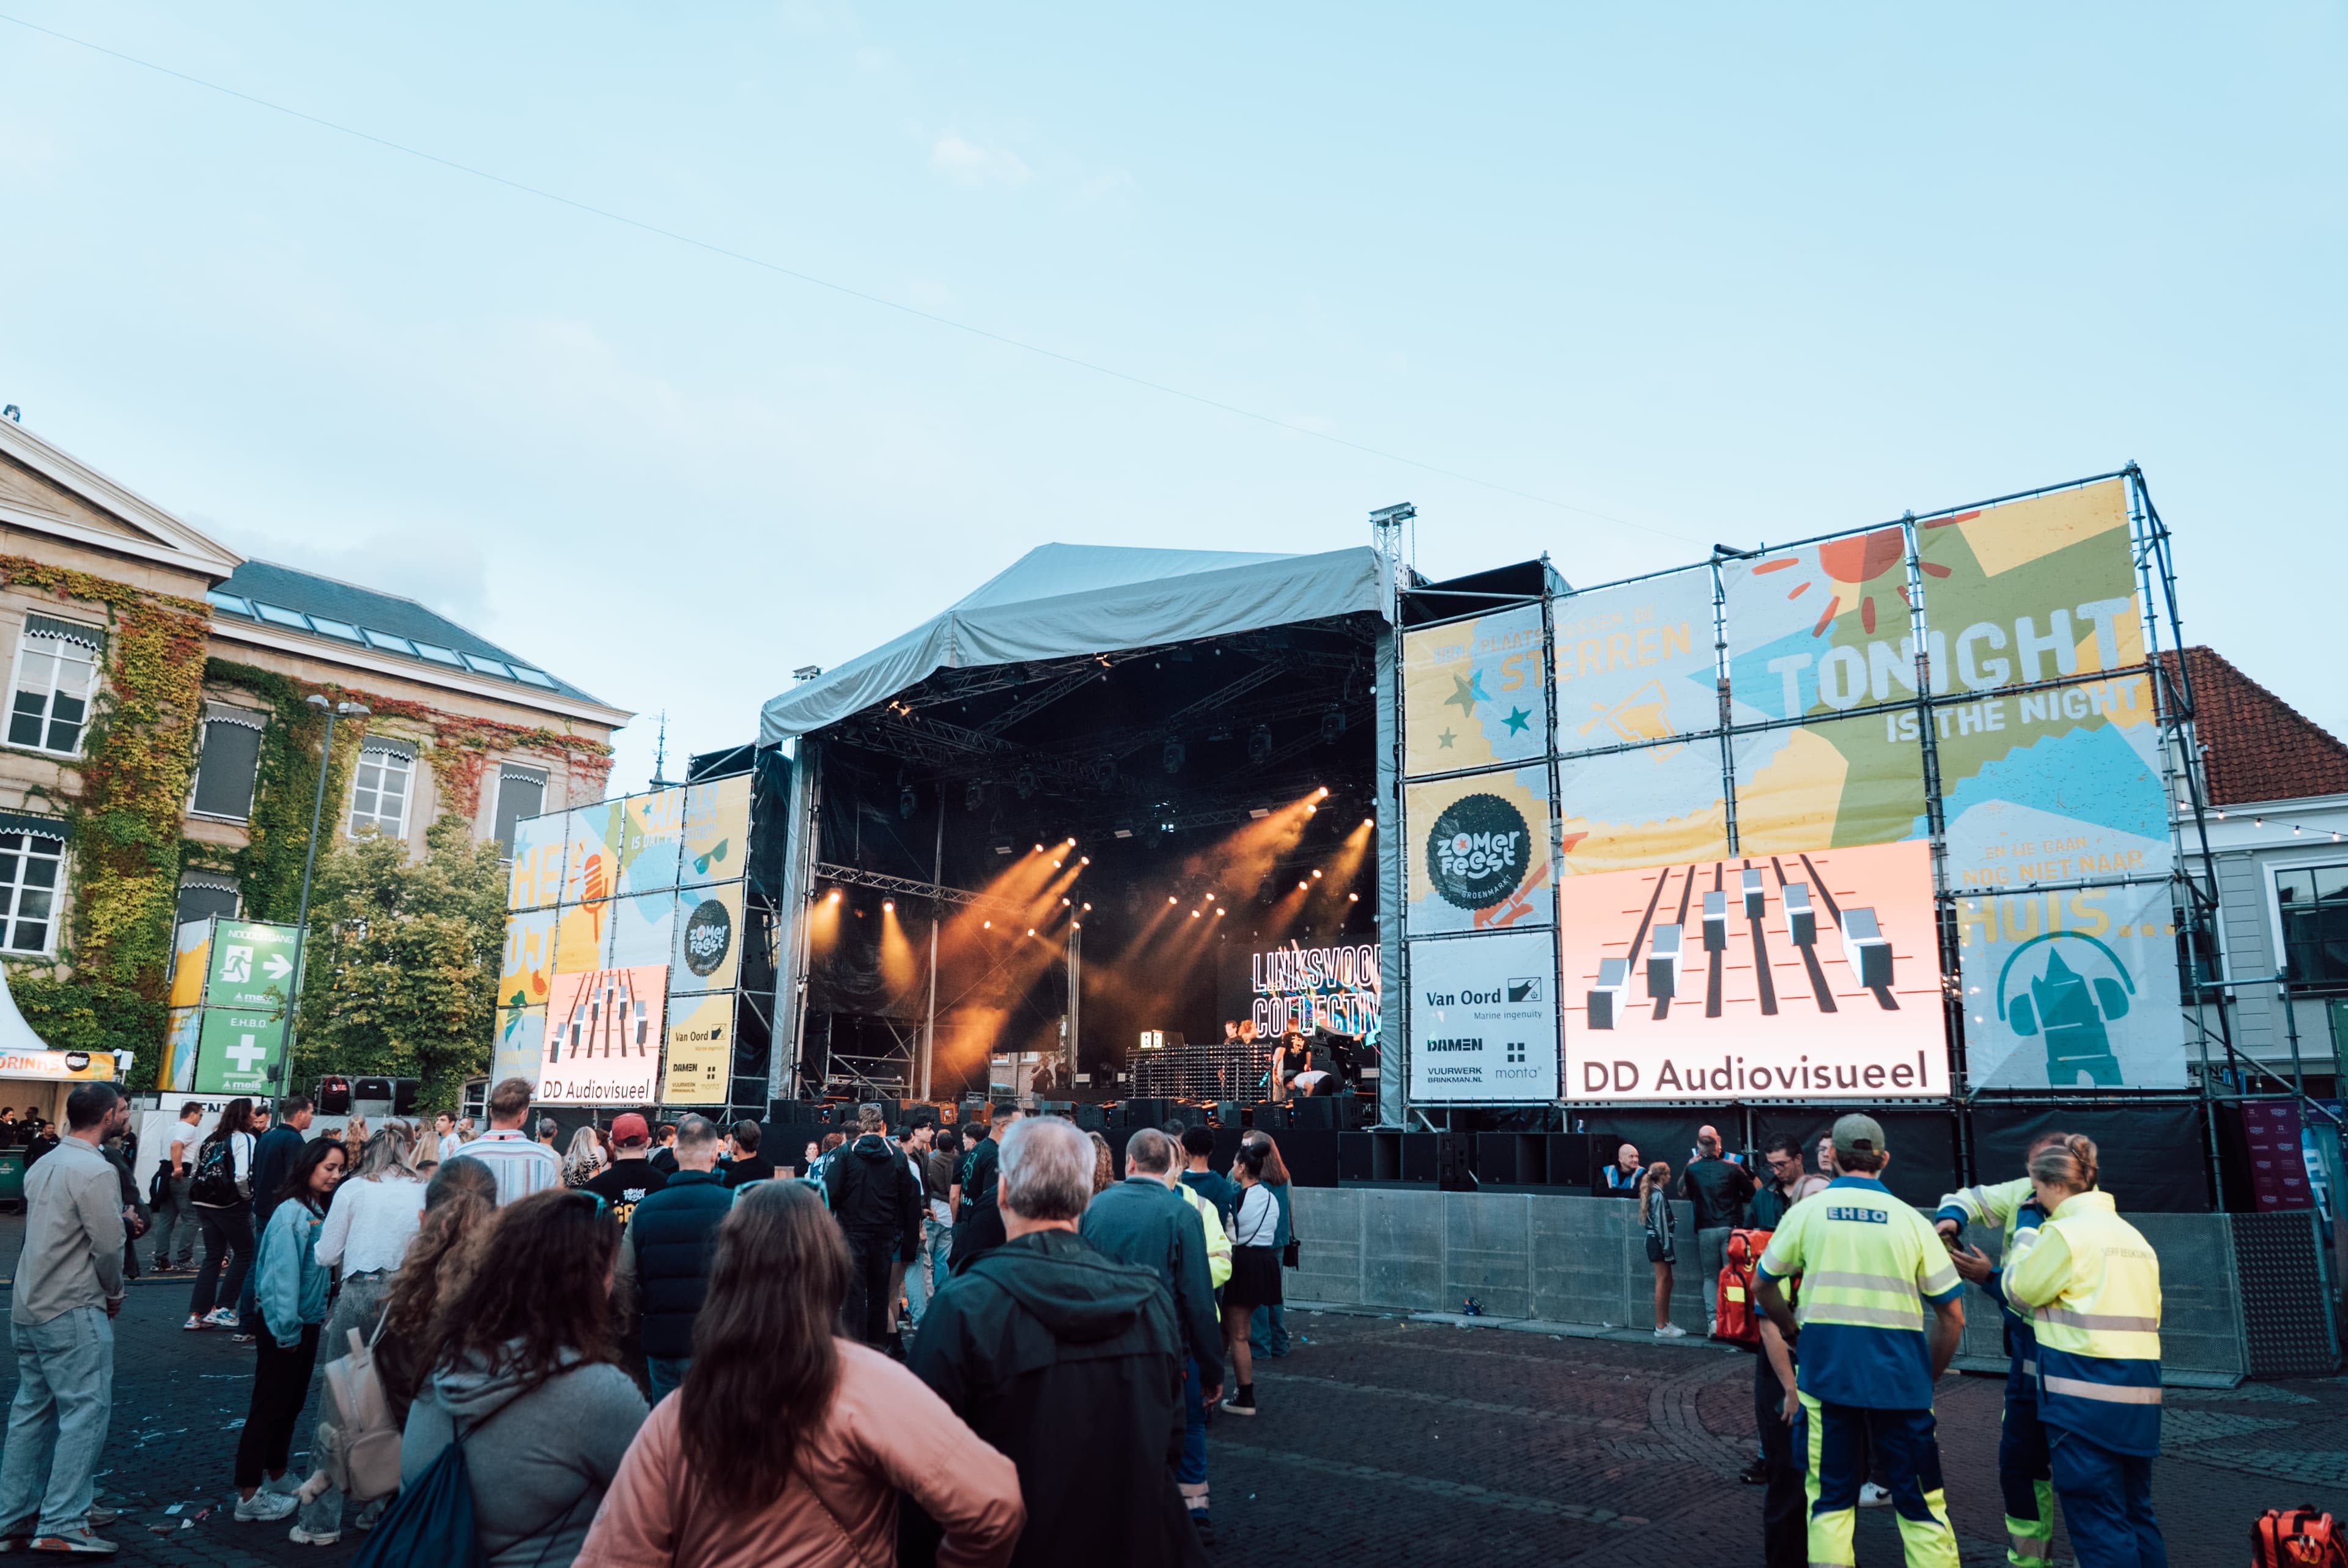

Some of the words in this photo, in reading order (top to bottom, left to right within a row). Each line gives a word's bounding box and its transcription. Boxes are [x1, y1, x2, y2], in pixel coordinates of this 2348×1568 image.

[1434, 645, 1464, 664] EEN
[1480, 628, 1543, 653] PLAATS
[1555, 610, 1623, 638] TUSSEN
[1633, 603, 1656, 624] DE
[1501, 621, 1691, 691] STERREN
[1768, 596, 2131, 722] TONIGHT
[1887, 713, 1919, 743] IS
[1934, 701, 2006, 739] THE
[2020, 677, 2140, 724] NIGHT
[648, 783, 719, 832] WAAR
[631, 835, 641, 850] IS
[1985, 844, 2006, 859] EN
[2012, 841, 2036, 857] WE
[2043, 836, 2088, 854] GAAN
[511, 837, 587, 910] HEY
[1962, 866, 2010, 886] NOG
[2019, 858, 2072, 881] NIET
[2079, 849, 2145, 873] NAAR
[1461, 874, 1512, 900] GROENMARKT
[504, 917, 555, 977] DJ
[1427, 992, 1455, 1006] Van
[1461, 988, 1501, 1005] Oord
[231, 1017, 268, 1028] E.H.B.O.
[1474, 1011, 1501, 1020] Marine
[1504, 1010, 1542, 1021] ingenuity
[676, 1031, 688, 1042] Van
[690, 1030, 709, 1041] Oord
[1427, 1038, 1483, 1052] DAMEN
[673, 1063, 698, 1072] DAMEN
[1428, 1067, 1482, 1075] VUURWERK
[1496, 1066, 1537, 1079] monta
[1584, 1060, 1639, 1092] DD
[1655, 1050, 1929, 1091] Audiovisueel
[544, 1080, 562, 1099] DD
[566, 1078, 649, 1099] Audiovisueel
[1828, 1207, 1886, 1222] EHBO
